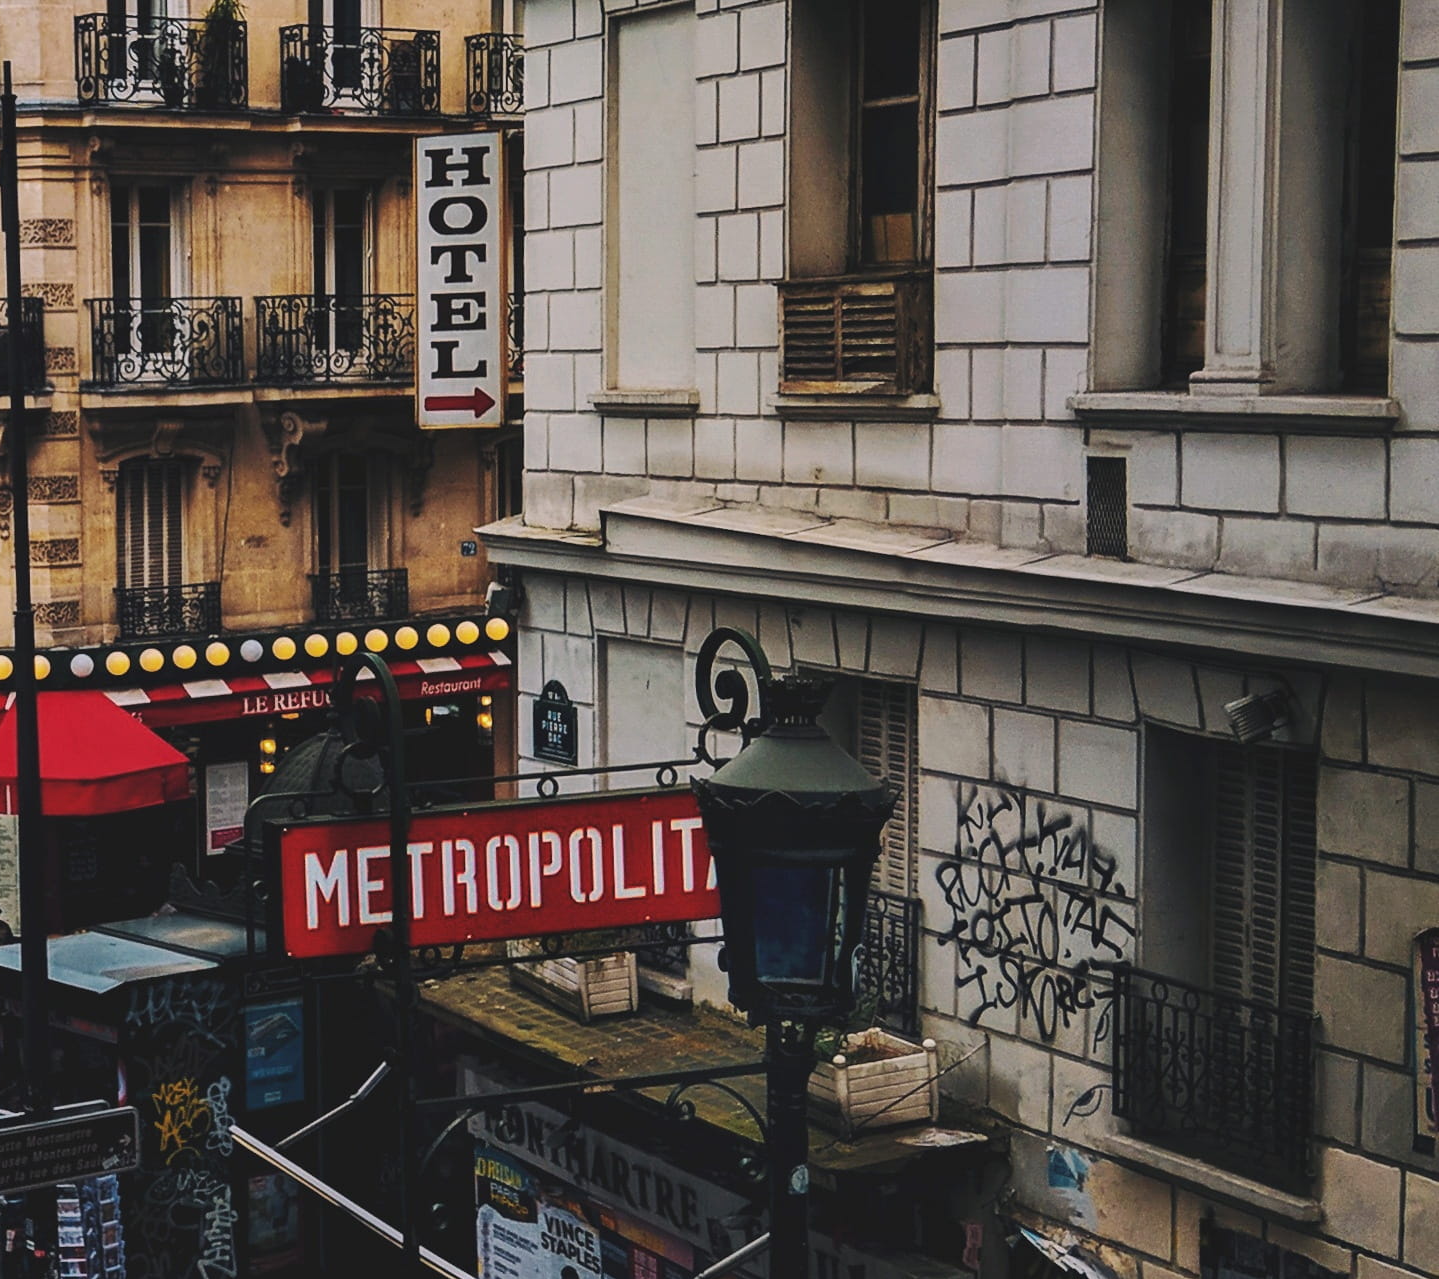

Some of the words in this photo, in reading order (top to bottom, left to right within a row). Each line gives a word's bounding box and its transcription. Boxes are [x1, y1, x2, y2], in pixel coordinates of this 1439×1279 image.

[424, 146, 491, 380] HOTEL
[420, 676, 482, 696] Restaurant
[242, 696, 268, 715] LE
[26, 1128, 93, 1149] Montmartre
[32, 1143, 99, 1161] Montmartre
[29, 1167, 49, 1180] rue
[52, 1162, 72, 1176] des
[544, 1213, 595, 1252] VINCE
[541, 1231, 601, 1275] STAPLES
